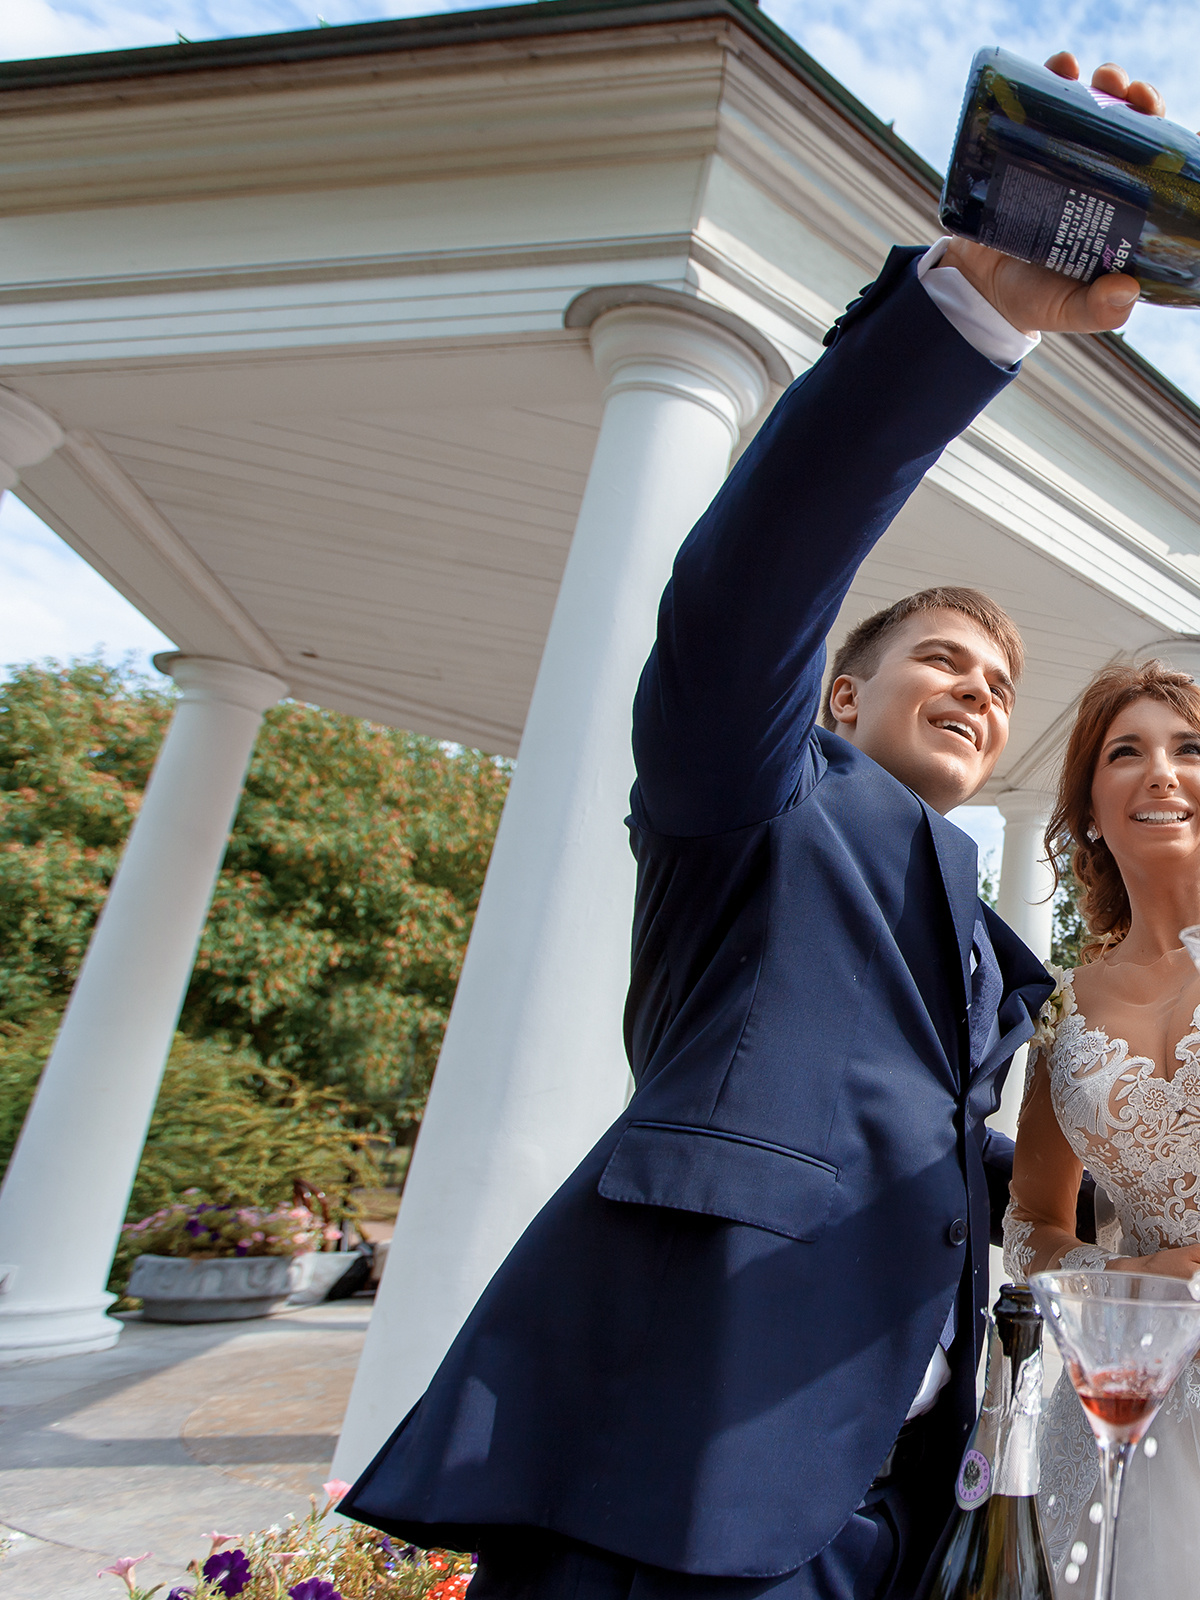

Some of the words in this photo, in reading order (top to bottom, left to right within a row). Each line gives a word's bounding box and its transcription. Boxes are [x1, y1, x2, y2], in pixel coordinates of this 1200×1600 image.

[1054, 200, 1076, 246] СВЕЖИМ
[1088, 200, 1105, 237] МОЛОДОГО
[1100, 203, 1115, 232] ABRAU
[1092, 232, 1107, 255] LIGHT
[1102, 244, 1116, 270] Light
[1110, 238, 1131, 273] ABRA
